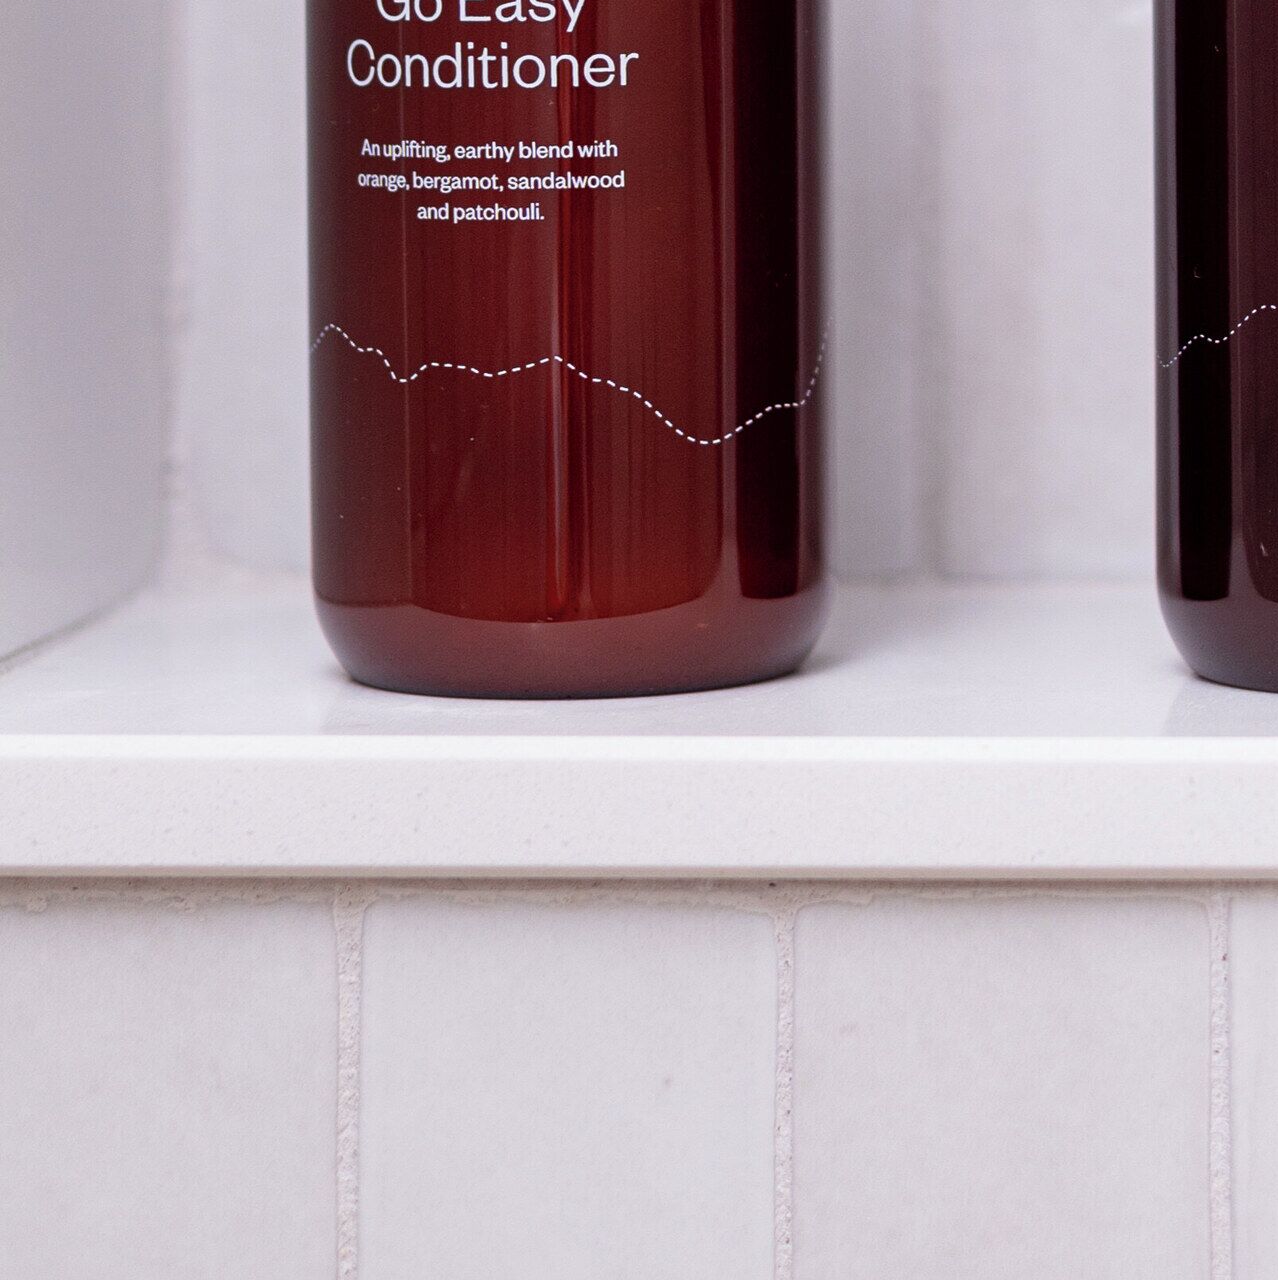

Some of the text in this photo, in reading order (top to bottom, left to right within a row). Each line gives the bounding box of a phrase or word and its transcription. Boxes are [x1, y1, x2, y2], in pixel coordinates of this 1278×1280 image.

[347, 38, 640, 89] Conditioner
[361, 138, 618, 163] An uplifting, earthy blend with
[357, 169, 625, 194] orange, bergamot, sandalwood
[416, 202, 545, 224] and patchouli.
